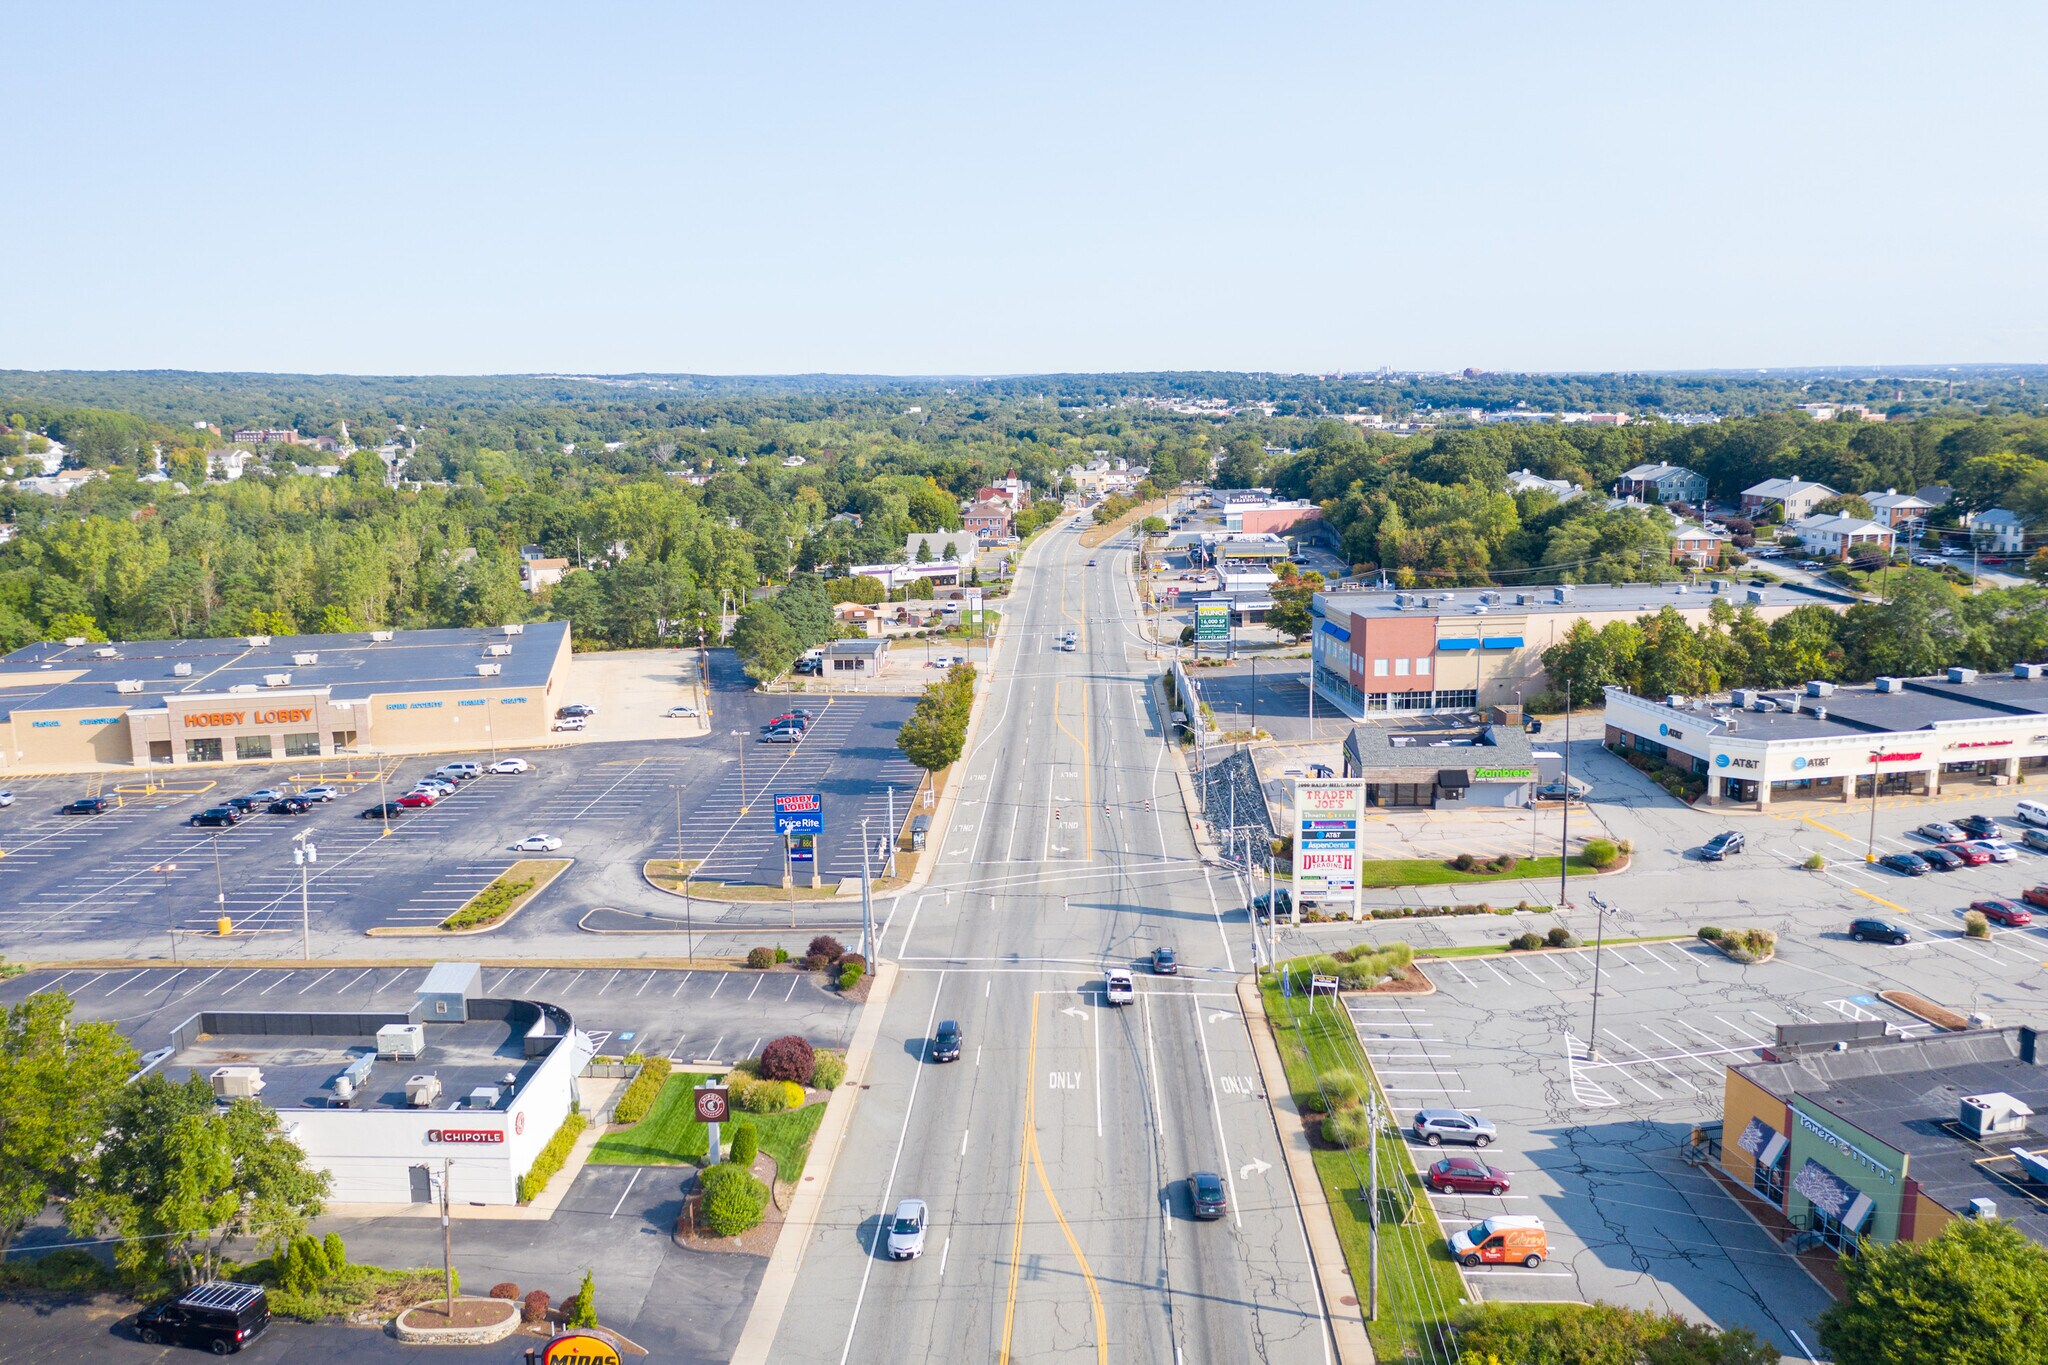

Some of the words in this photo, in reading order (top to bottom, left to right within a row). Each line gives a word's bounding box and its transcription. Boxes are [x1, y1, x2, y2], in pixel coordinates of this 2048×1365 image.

[184, 711, 246, 728] HOBBY
[254, 708, 313, 724] LOBBY
[1668, 728, 1684, 740] AT&T
[1732, 758, 1760, 769] AT&T
[1807, 757, 1831, 767] AT&T
[1475, 767, 1531, 778] Zambrero
[776, 795, 813, 805] HOBBY
[1306, 790, 1353, 800] TRADER
[784, 802, 819, 812] LOBBY
[1314, 800, 1345, 809] JOE'S
[802, 818, 819, 827] Rite
[1058, 821, 1079, 829] ONLY
[953, 824, 975, 832] ONLY
[1303, 854, 1353, 870] DULUTH
[1049, 1071, 1082, 1090] ONLY
[1220, 1075, 1254, 1095] ONLY
[1800, 1115, 1837, 1148] Panera
[444, 1132, 501, 1142] CHIPOTLE
[1853, 1151, 1895, 1185] BREAD
[549, 1355, 617, 1365] MIDAS
